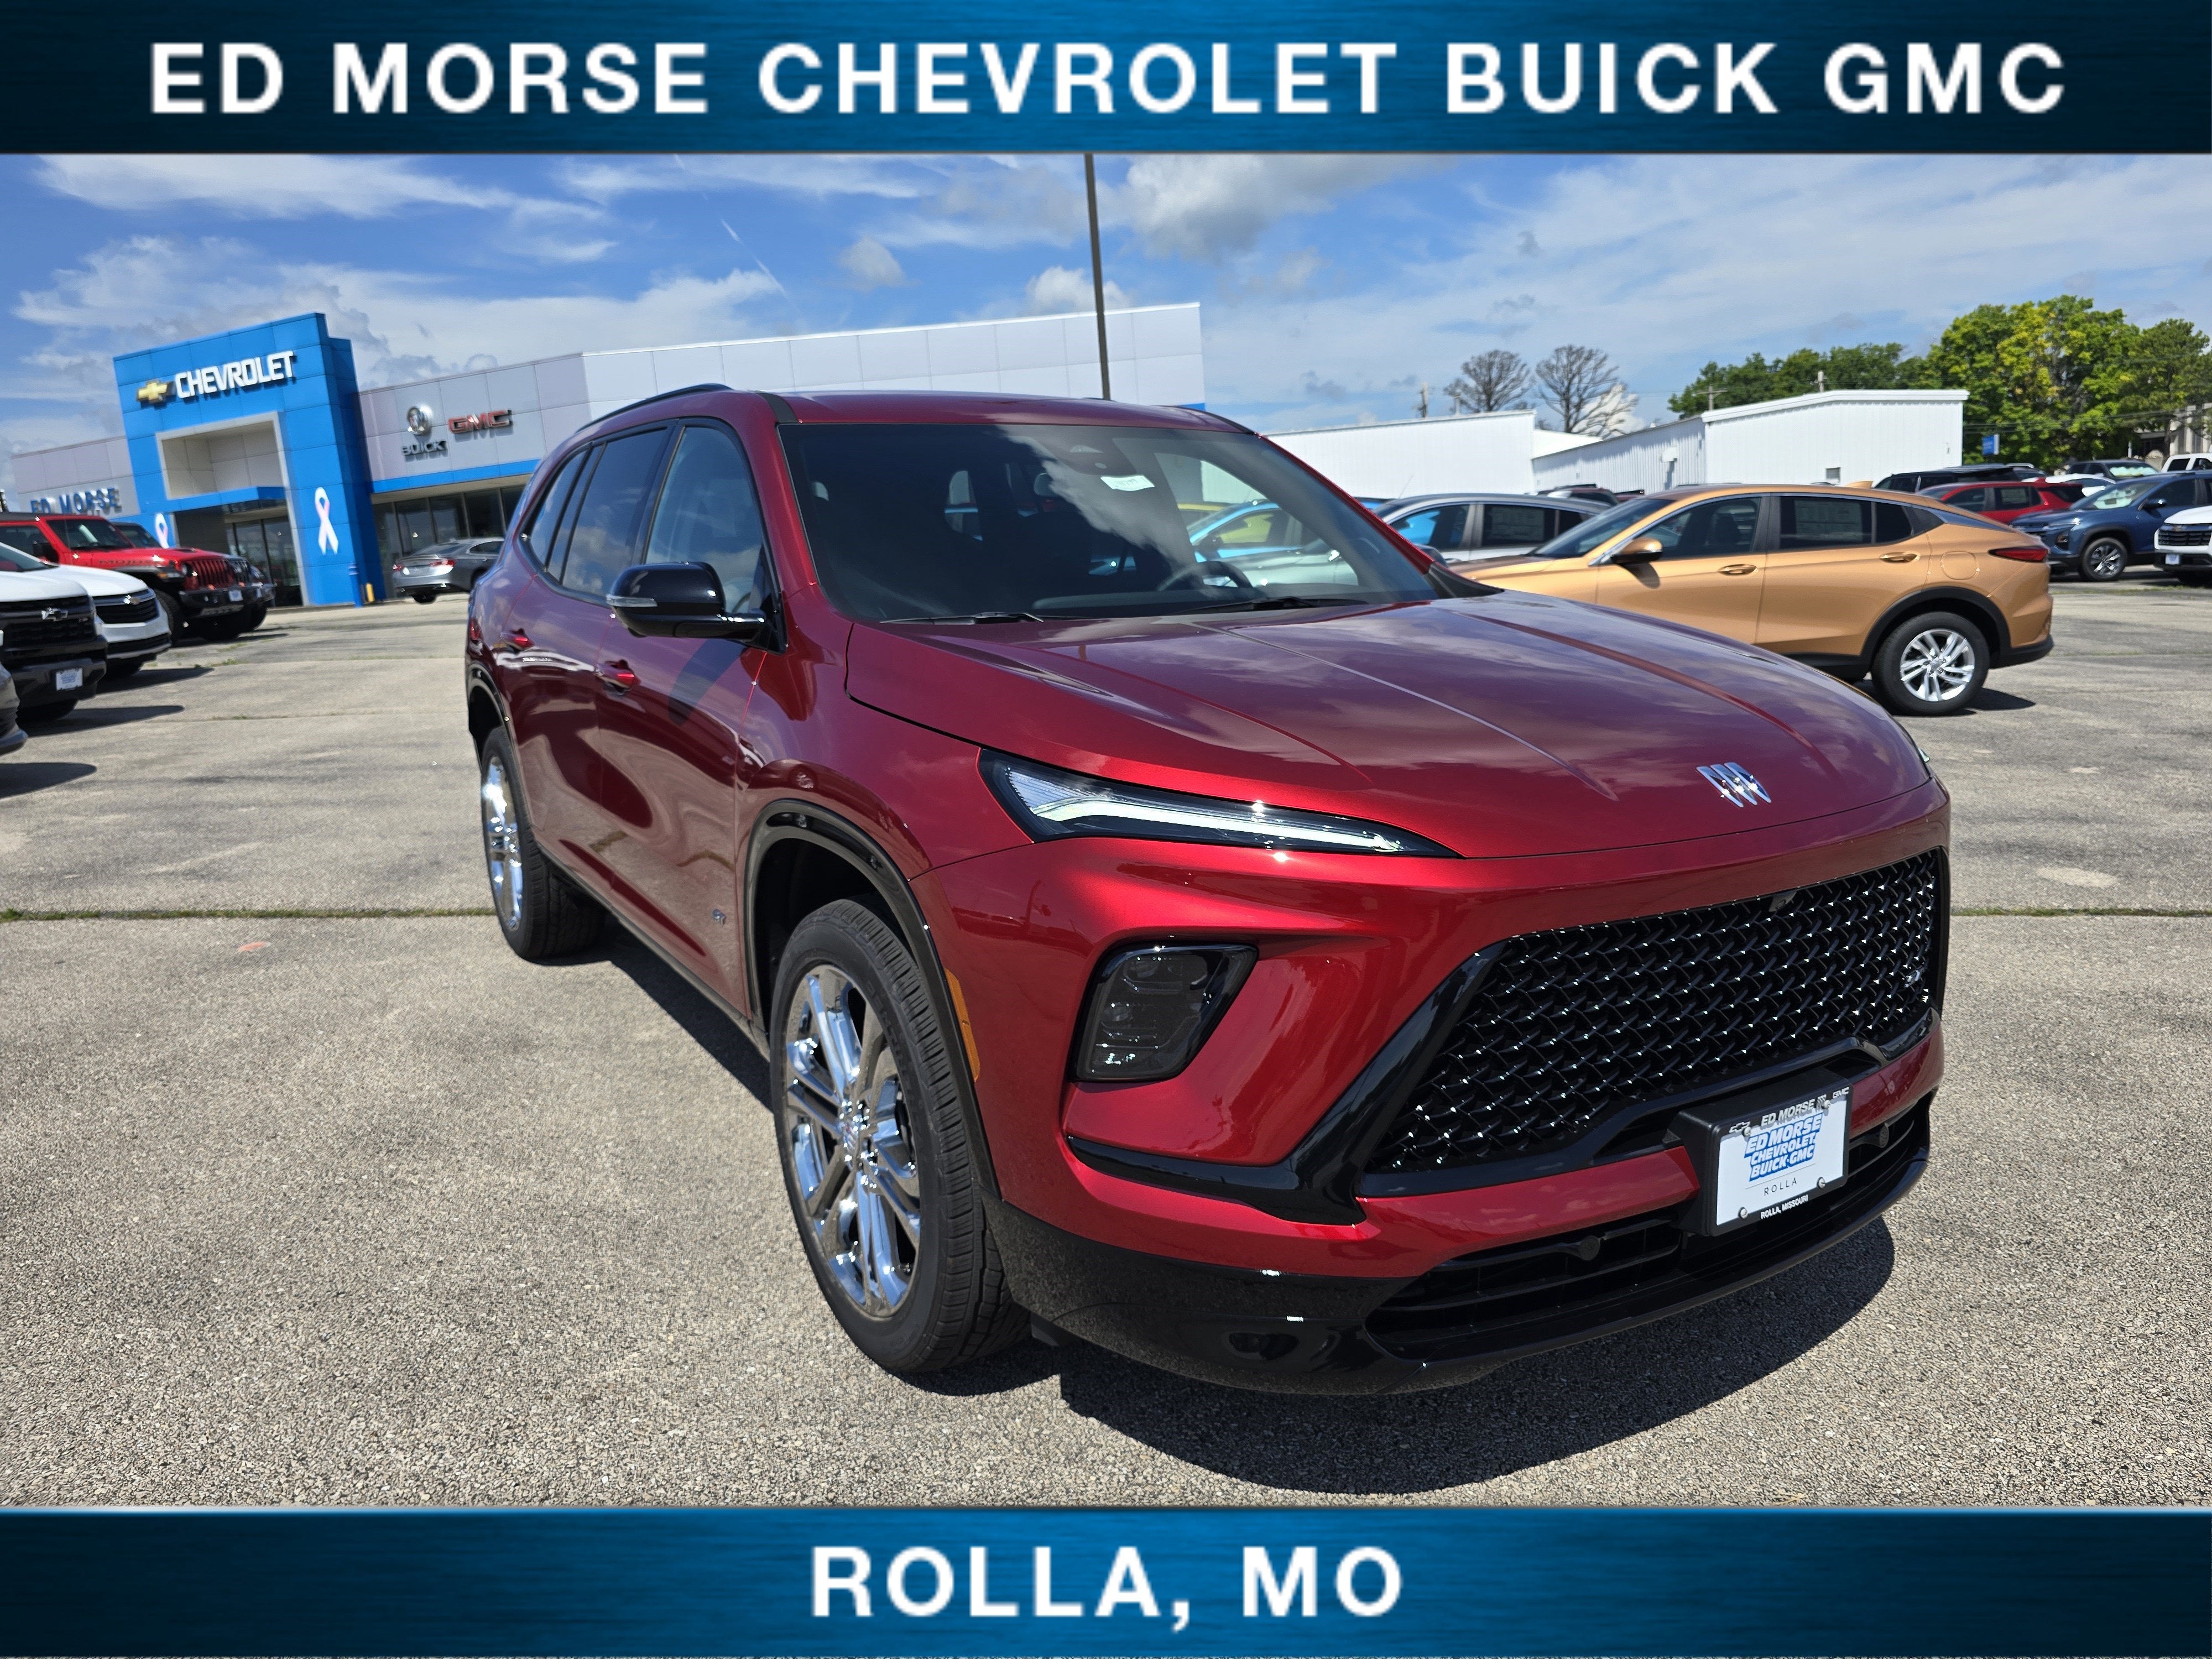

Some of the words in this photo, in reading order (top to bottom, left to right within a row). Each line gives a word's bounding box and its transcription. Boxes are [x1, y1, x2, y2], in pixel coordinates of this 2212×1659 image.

[174, 350, 294, 399] CHEVROLET
[448, 409, 512, 434] GMC
[401, 441, 447, 456] BUICK
[30, 497, 54, 514] ED
[59, 488, 122, 515] MORSE
[1832, 1087, 1850, 1099] GMC
[1761, 1112, 1777, 1126] ED
[1778, 1098, 1815, 1120] MORSE
[1745, 1132, 1770, 1158] ED
[1768, 1112, 1823, 1147] MORSE
[1764, 1177, 1797, 1196] ROLLA
[1760, 1206, 1782, 1219] ROLLA,
[1782, 1194, 1809, 1212] MISSOURI
